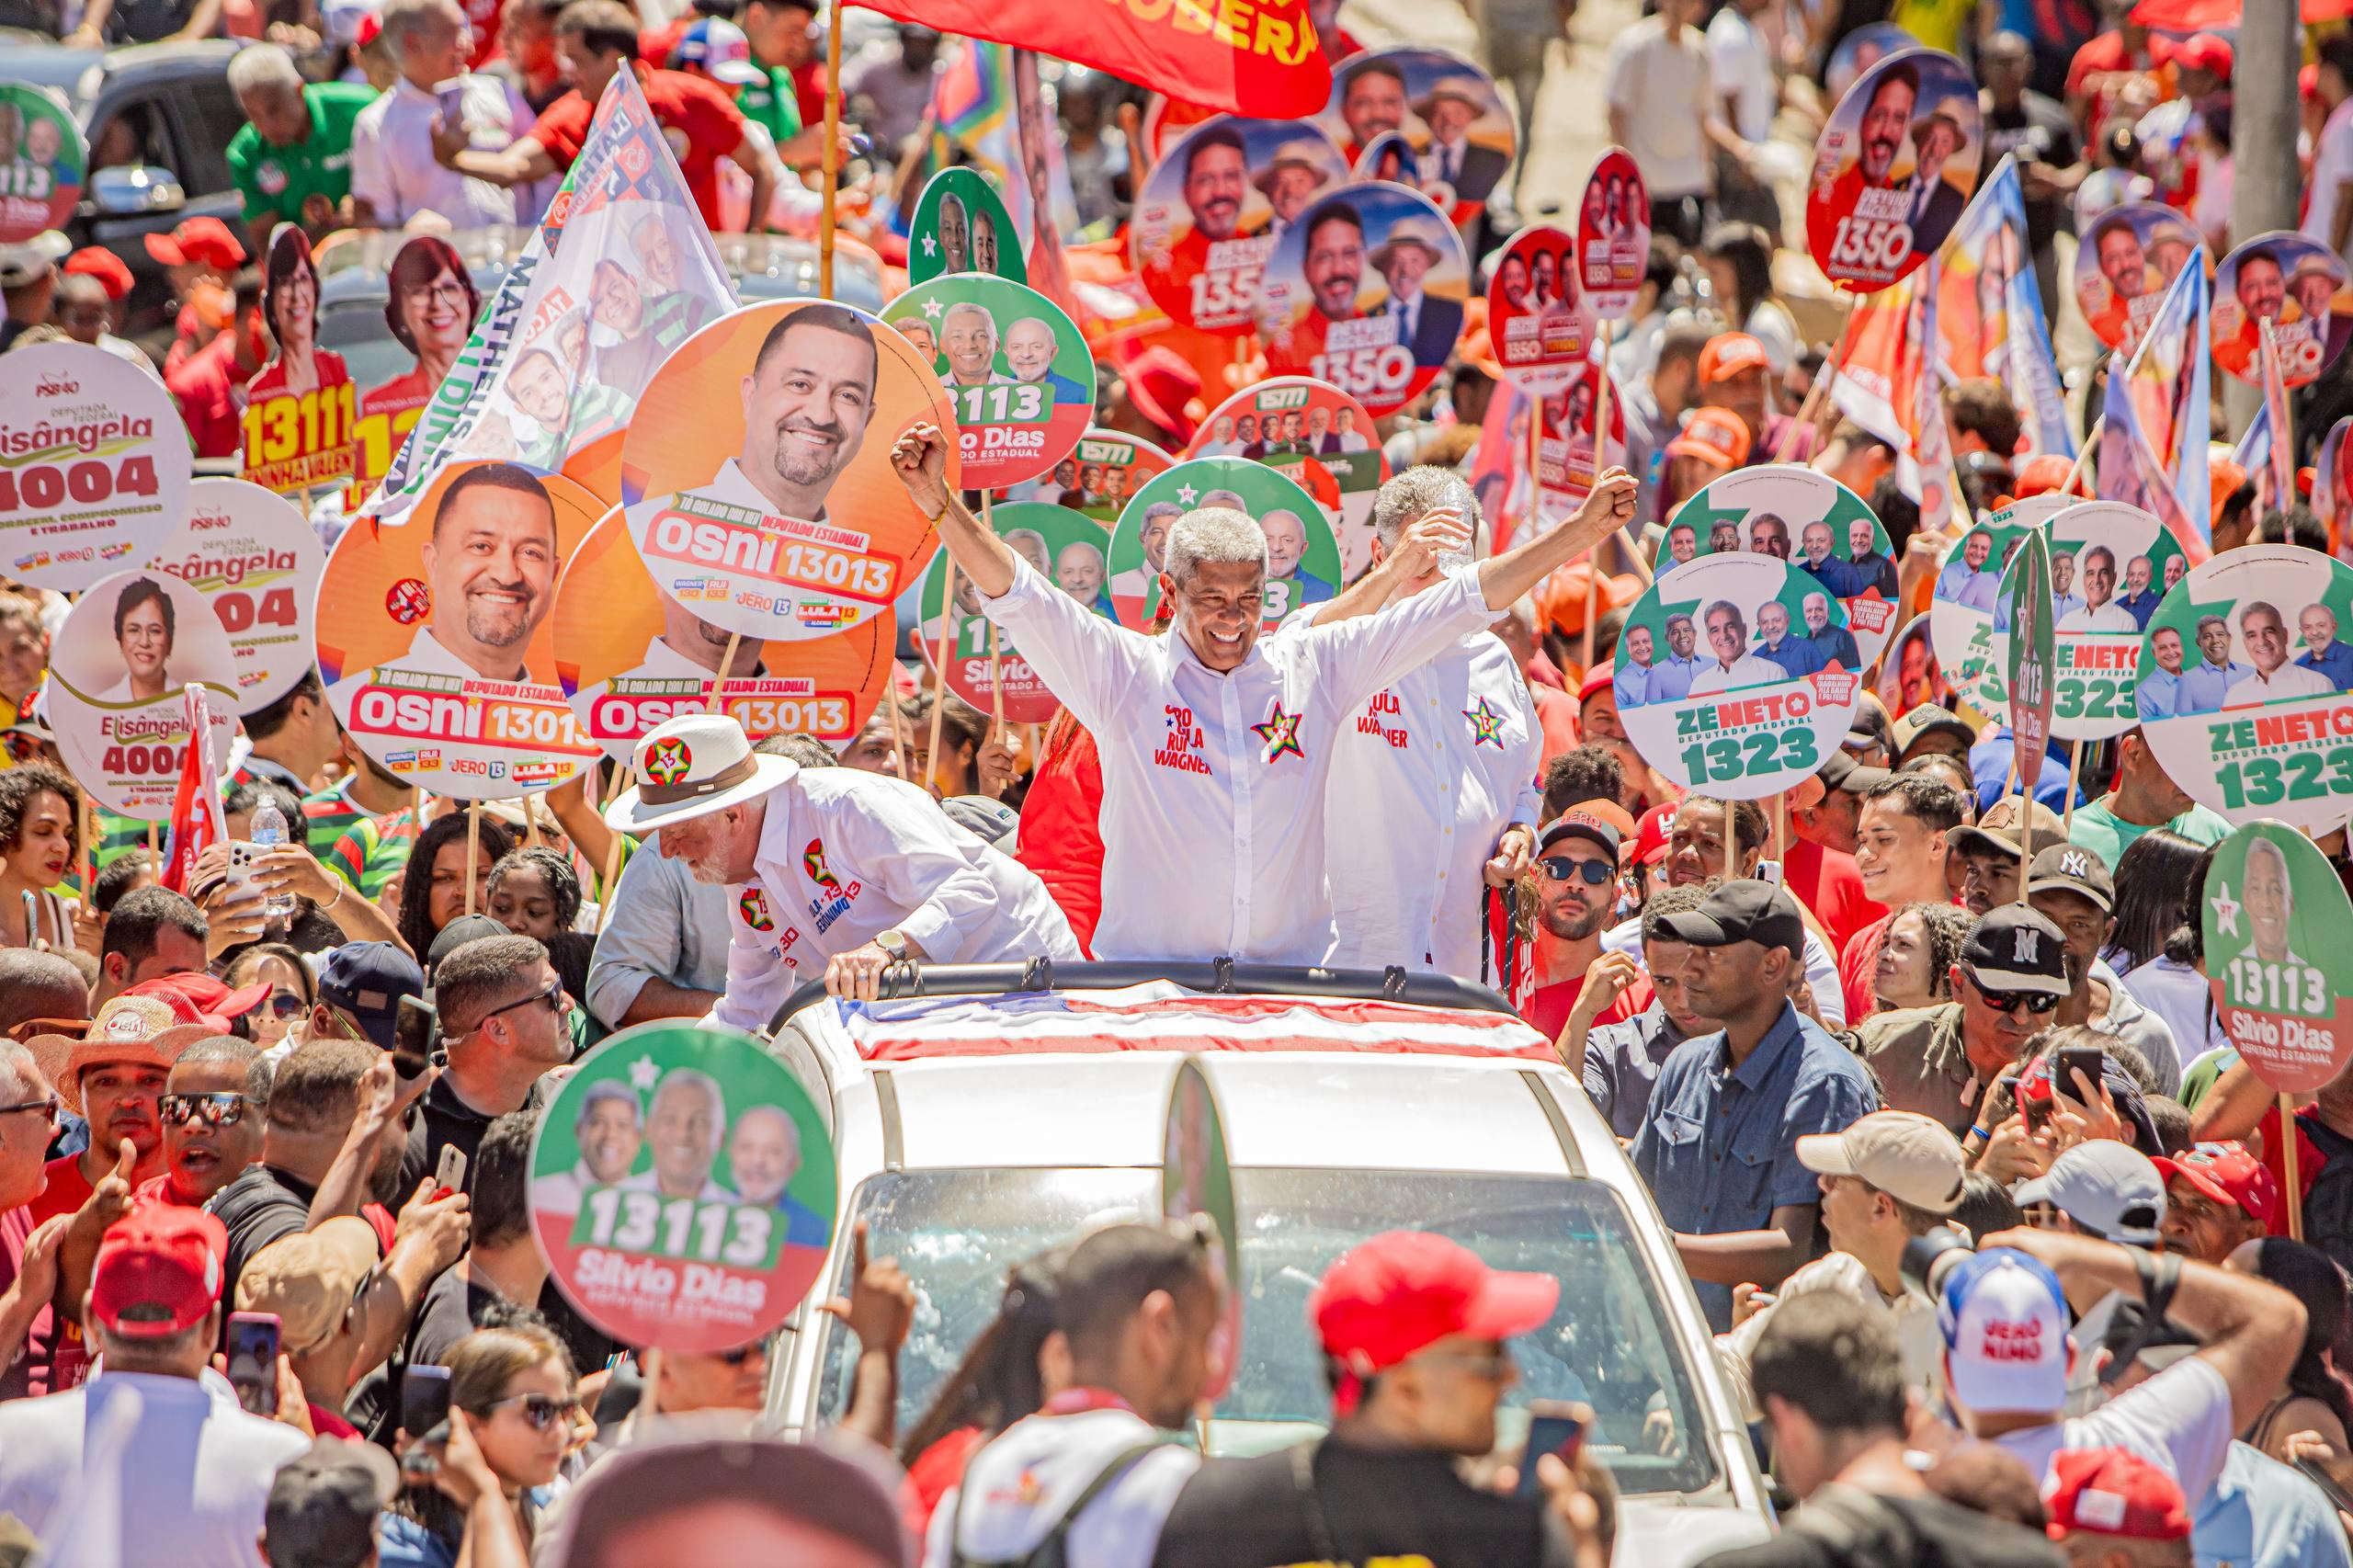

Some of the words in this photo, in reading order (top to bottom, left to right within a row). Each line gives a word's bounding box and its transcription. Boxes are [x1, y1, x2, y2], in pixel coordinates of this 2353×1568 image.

[1828, 215, 1915, 270] 1350
[243, 381, 356, 469] 13111
[983, 426, 1045, 449] Dias
[760, 513, 814, 538] DEPUTADO
[814, 525, 866, 549] ESTADUAL
[785, 544, 892, 594] 13013
[775, 598, 790, 615] 13
[798, 606, 841, 618] LULA
[463, 679, 517, 699] DEPUTADO
[757, 679, 810, 693] ESTADUAL
[733, 700, 845, 733] 13013
[1678, 726, 1748, 744] DEPUTADO
[1755, 716, 1813, 733] FEDERAL
[659, 750, 677, 770] 13
[1680, 726, 1820, 787] 1323
[2211, 744, 2289, 762] DEPUTADO
[513, 762, 558, 778] LULA
[2059, 849, 2088, 880] NY
[845, 880, 862, 902] 13
[2013, 926, 2039, 963] M
[2228, 957, 2327, 1016] 13113
[2232, 1010, 2279, 1048] Silvio
[2281, 1018, 2336, 1053] Dias
[2280, 1047, 2333, 1068] ESTADUAL
[588, 1188, 773, 1267] 13113
[574, 1248, 676, 1297] Silvio
[681, 1263, 767, 1311] Dias
